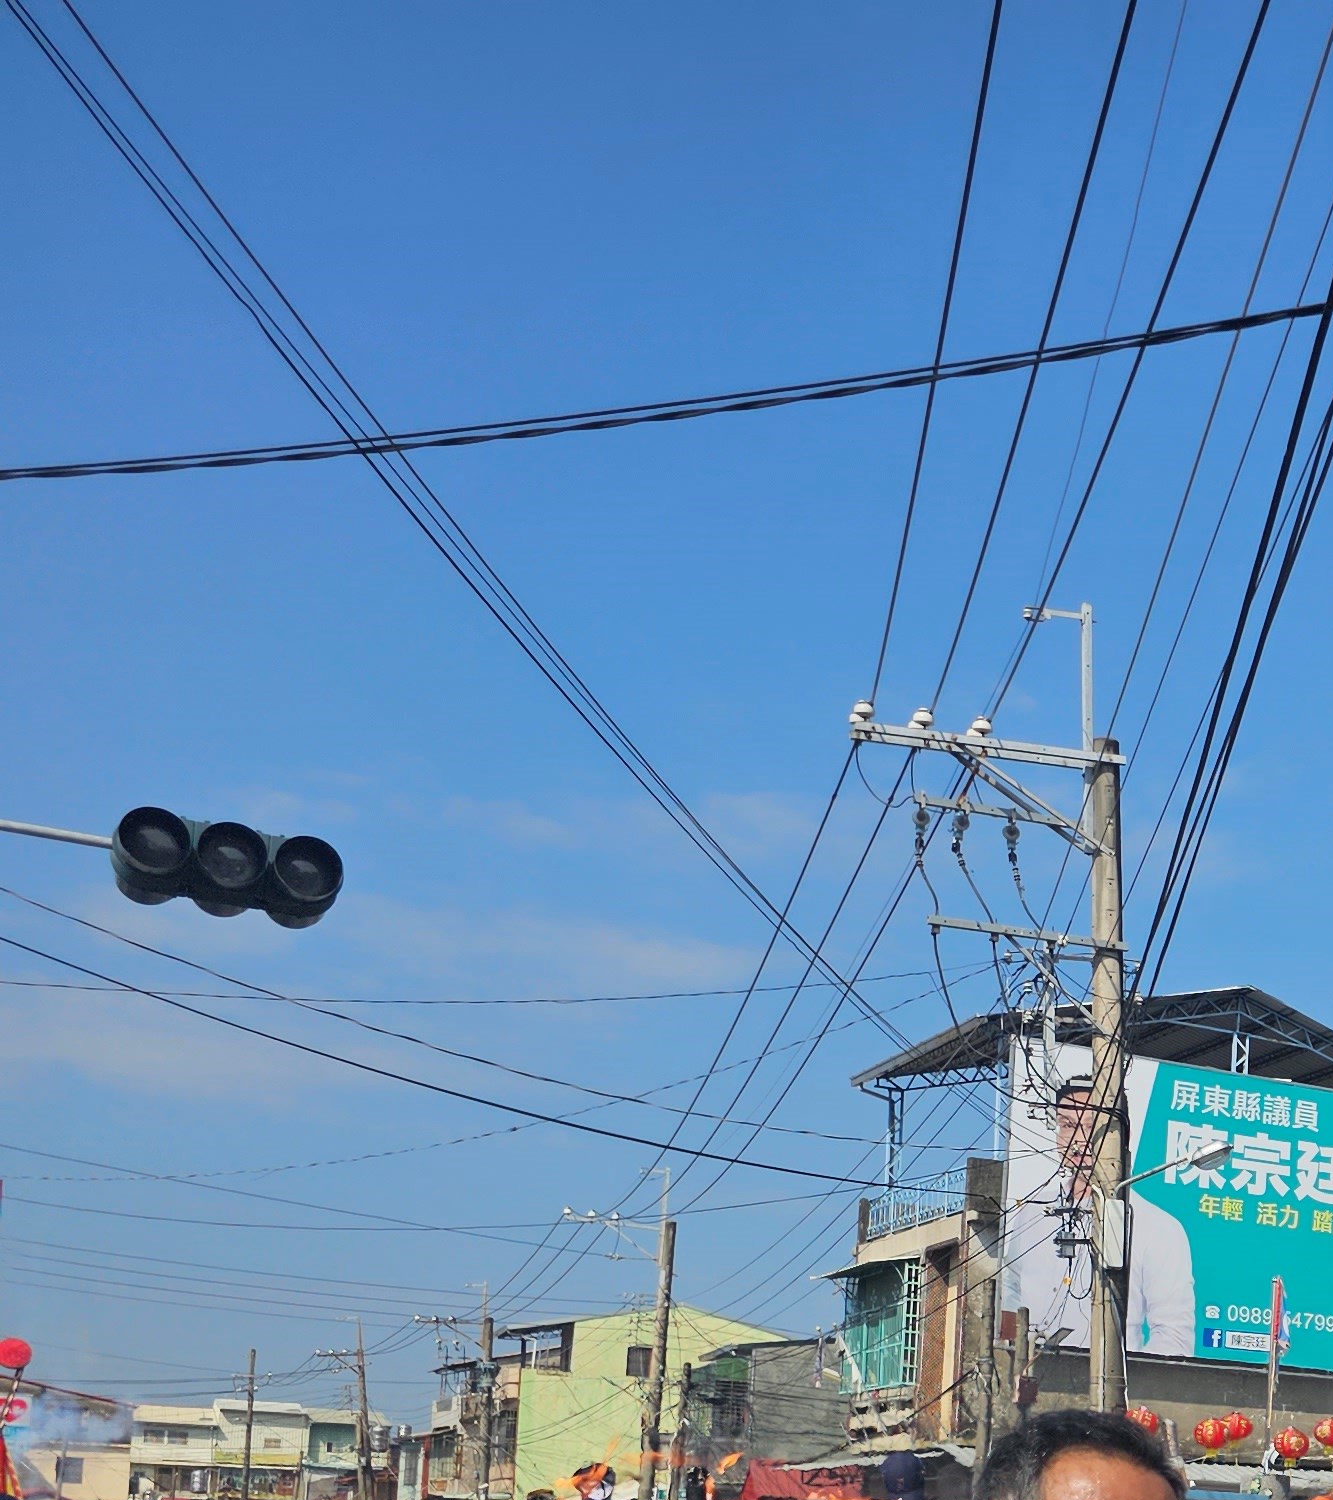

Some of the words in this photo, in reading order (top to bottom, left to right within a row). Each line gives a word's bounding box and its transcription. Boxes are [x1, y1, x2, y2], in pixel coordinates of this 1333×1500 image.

[1170, 1079, 1320, 1133] 屏東縣議員
[1198, 1193, 1244, 1223] 年輕
[1256, 1202, 1300, 1231] 活力
